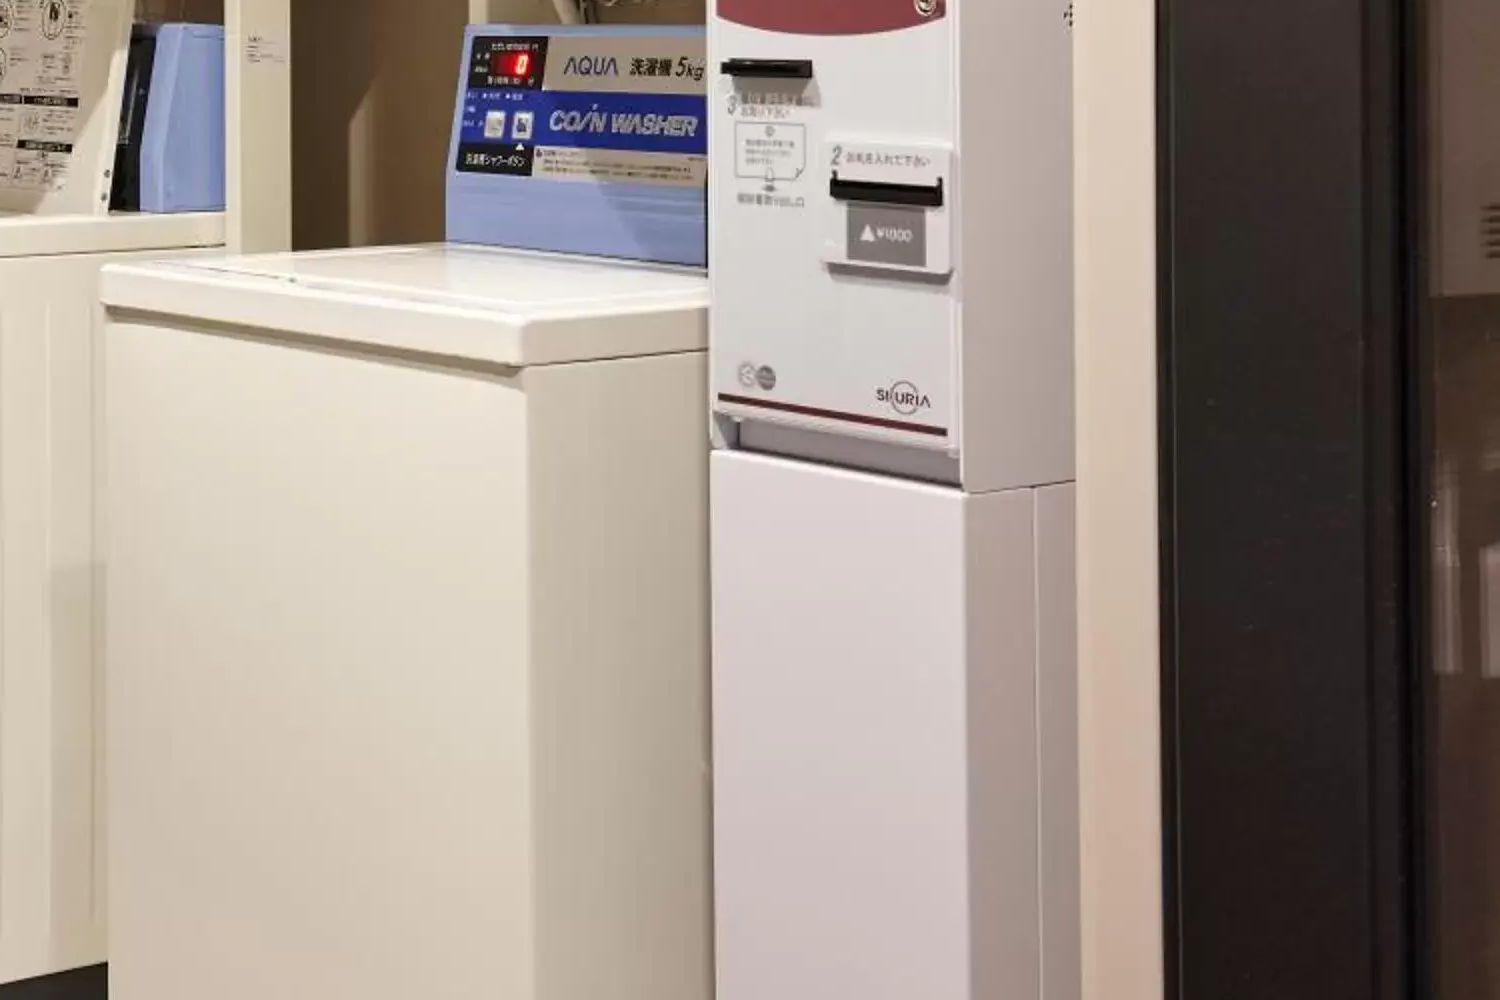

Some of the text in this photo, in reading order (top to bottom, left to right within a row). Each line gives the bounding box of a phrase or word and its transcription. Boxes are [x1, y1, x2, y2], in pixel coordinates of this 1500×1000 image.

[563, 55, 705, 81] AQUA 洗濯機 5kg
[549, 103, 607, 134] COIN
[611, 112, 699, 138] WASHER
[830, 144, 843, 166] 2
[876, 225, 913, 243] ¥1000
